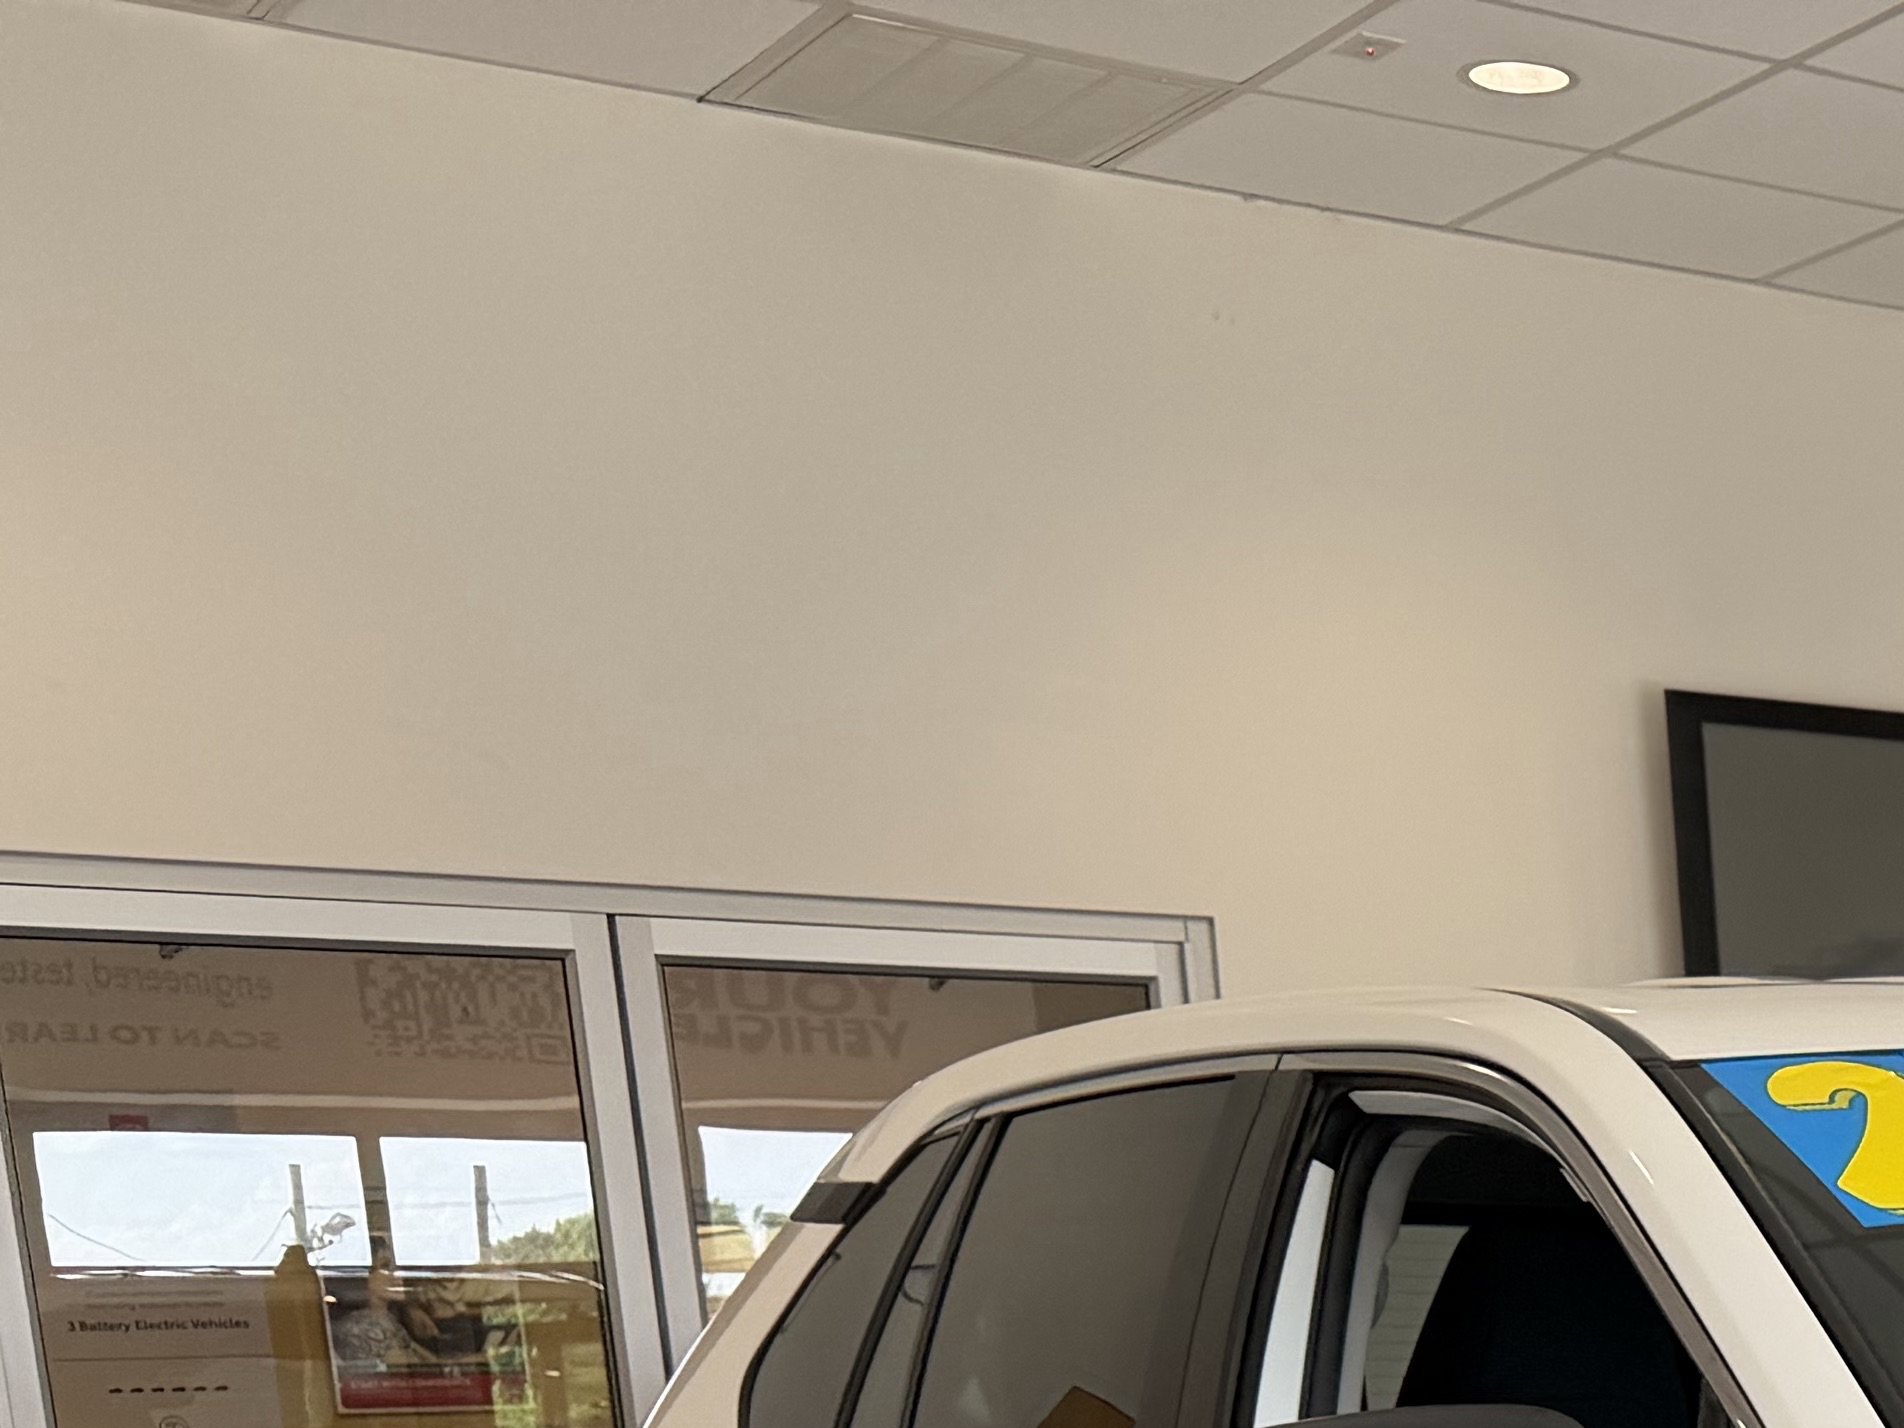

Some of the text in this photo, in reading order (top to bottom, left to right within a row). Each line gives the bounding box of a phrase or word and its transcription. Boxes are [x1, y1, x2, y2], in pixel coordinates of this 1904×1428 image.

[79, 1320, 131, 1334] Battery
[135, 1318, 186, 1331] Electric
[191, 1317, 251, 1331] Vehicles
